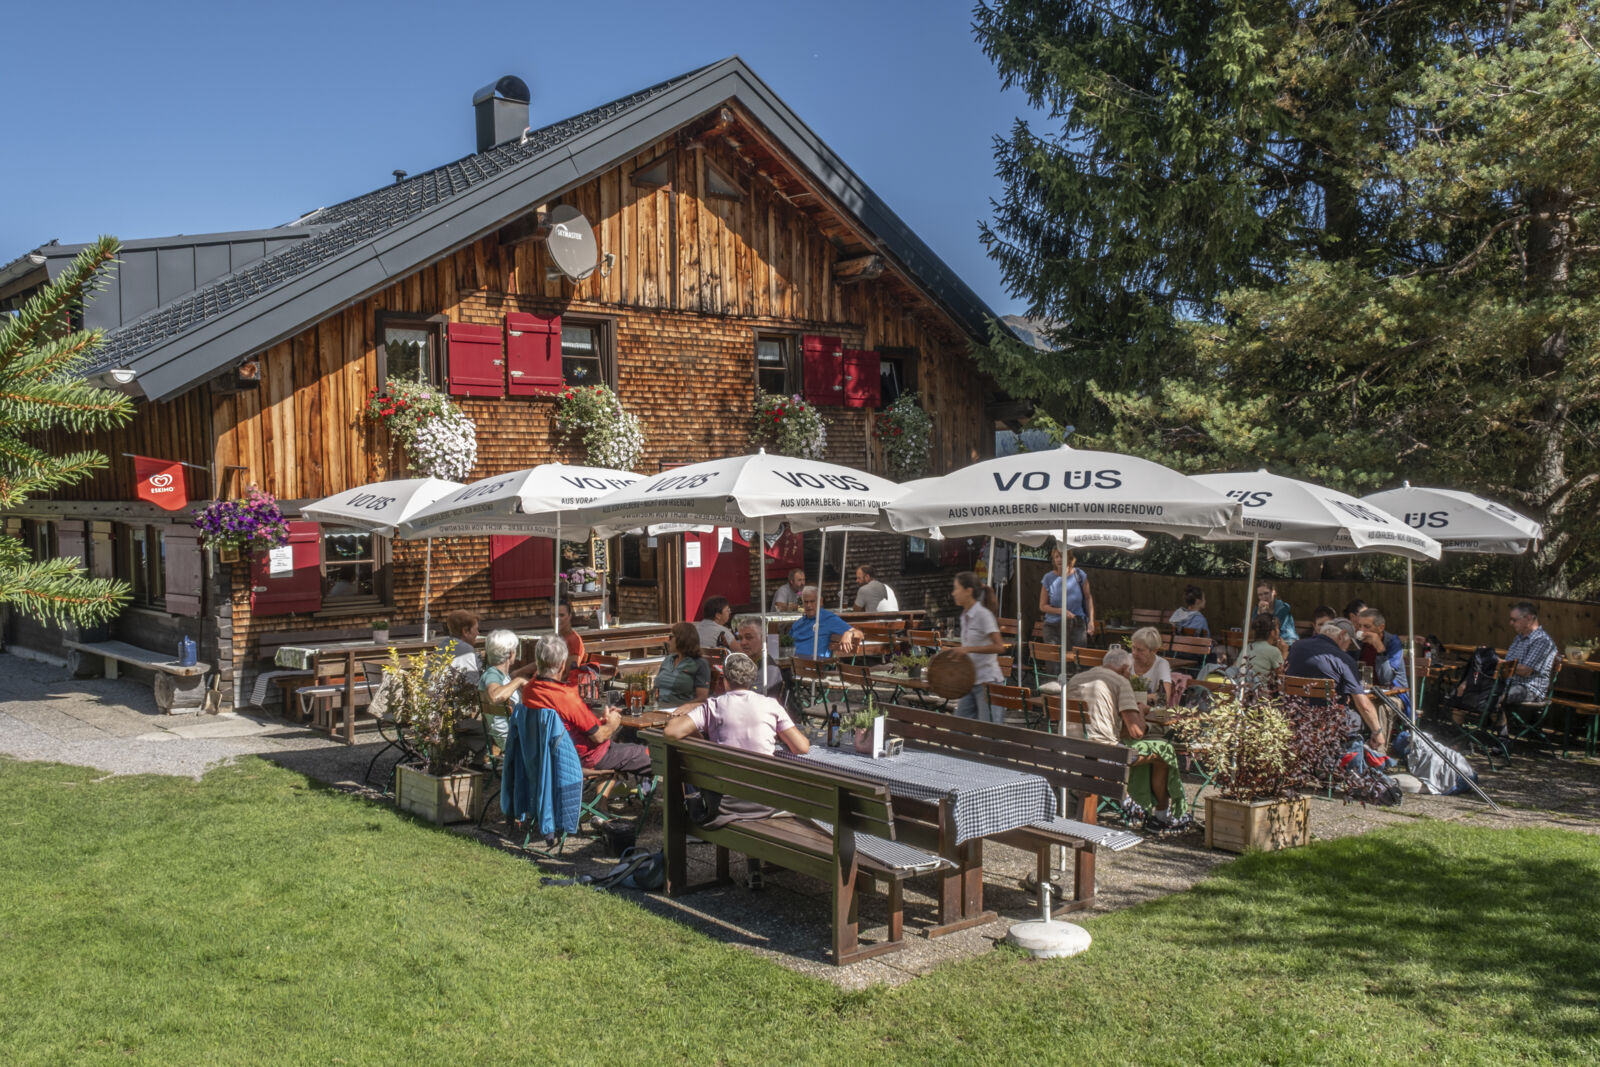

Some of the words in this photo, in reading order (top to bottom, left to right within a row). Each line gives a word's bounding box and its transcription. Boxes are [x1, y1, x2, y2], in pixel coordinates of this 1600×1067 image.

[560, 476, 607, 490] VO
[772, 470, 824, 488] VO
[819, 474, 869, 491] ÜS
[993, 472, 1050, 491] VO
[1064, 470, 1122, 490] ÜS
[781, 498, 795, 507] AUS
[796, 498, 840, 507] VORARLBERG
[847, 499, 866, 507] NICHT
[868, 501, 880, 509] VON
[949, 507, 968, 518] AUS
[971, 503, 1038, 517] VORARLBERG
[1049, 502, 1080, 513] NICHT
[1083, 503, 1105, 513] VON
[1107, 503, 1163, 515] IRGENDWO
